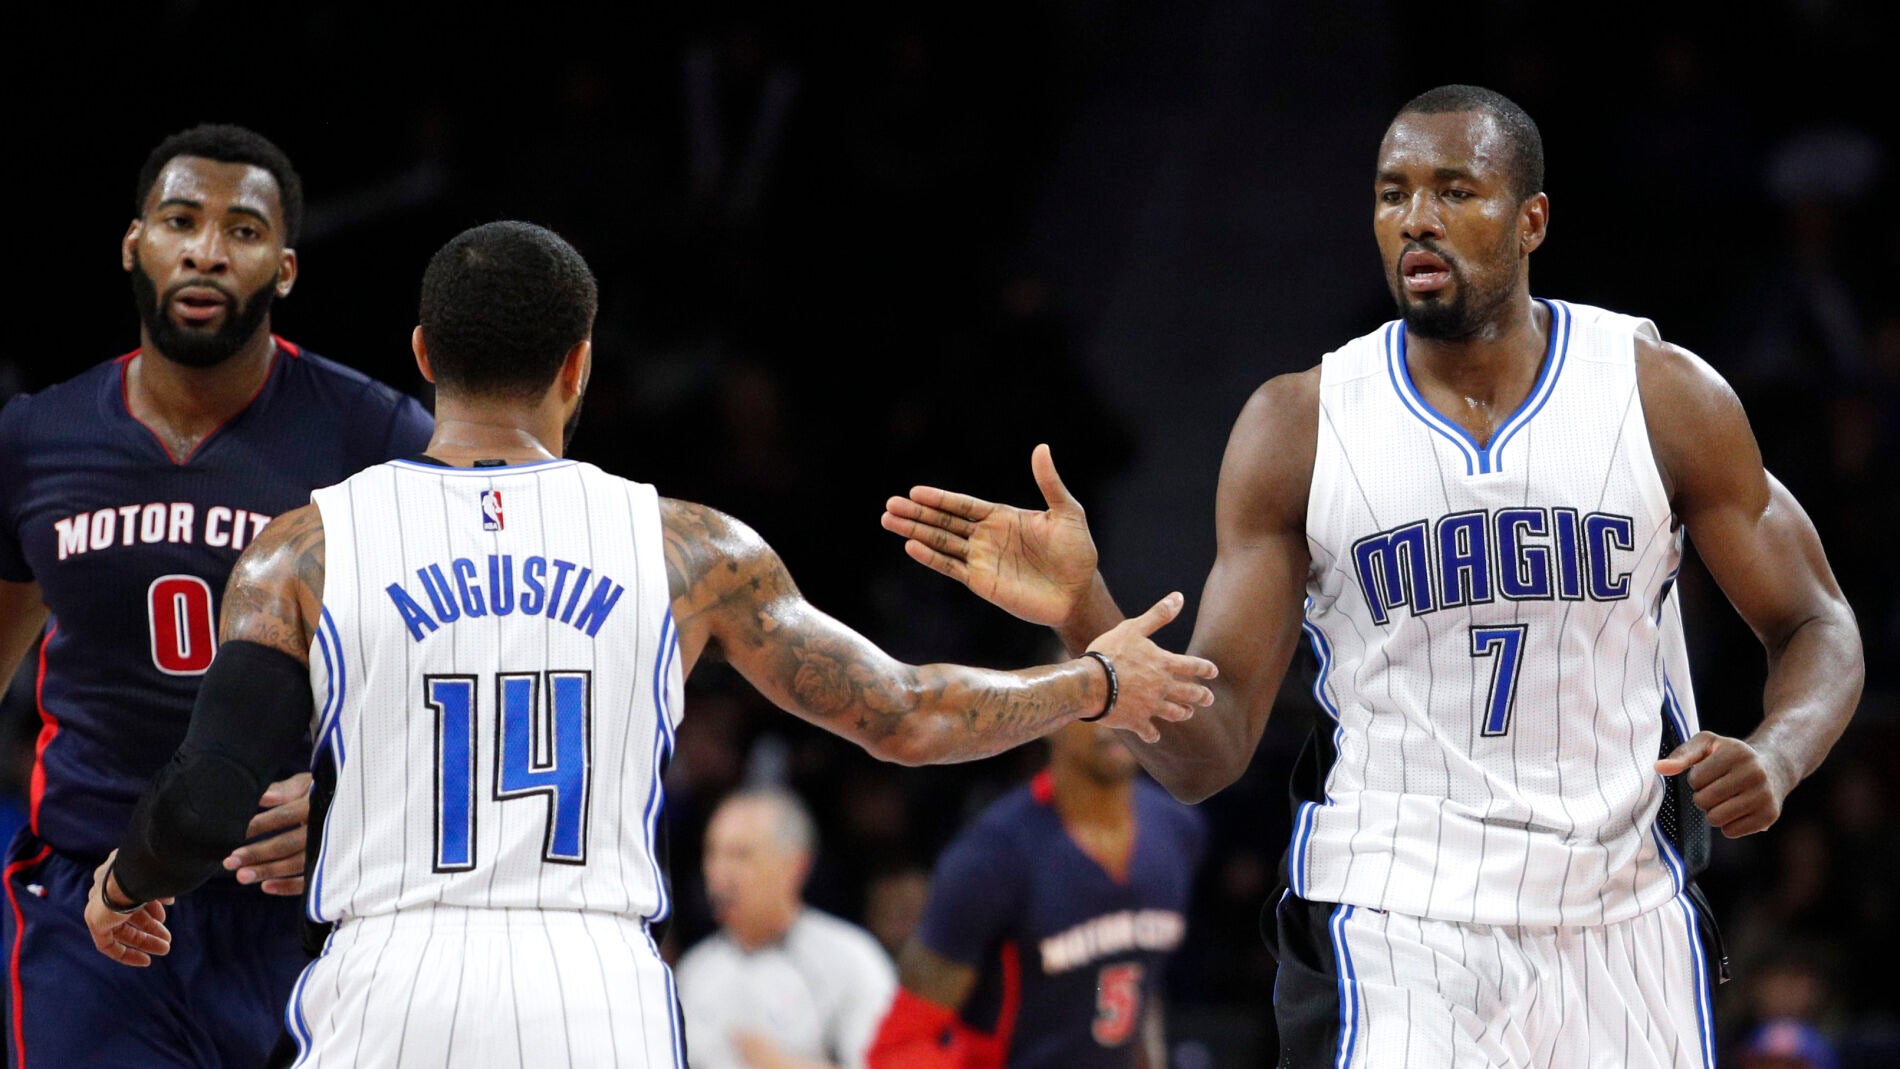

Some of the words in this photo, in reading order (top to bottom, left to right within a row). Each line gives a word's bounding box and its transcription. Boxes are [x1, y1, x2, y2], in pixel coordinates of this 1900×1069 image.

[54, 502, 195, 561] MOTOR
[204, 506, 272, 551] CIT
[1351, 506, 1635, 626] MAGIC
[147, 574, 217, 676] 0
[385, 554, 625, 643] AUGUSTIN
[1469, 623, 1528, 737] 7
[423, 670, 592, 874] 14
[1092, 963, 1143, 1046] 5
